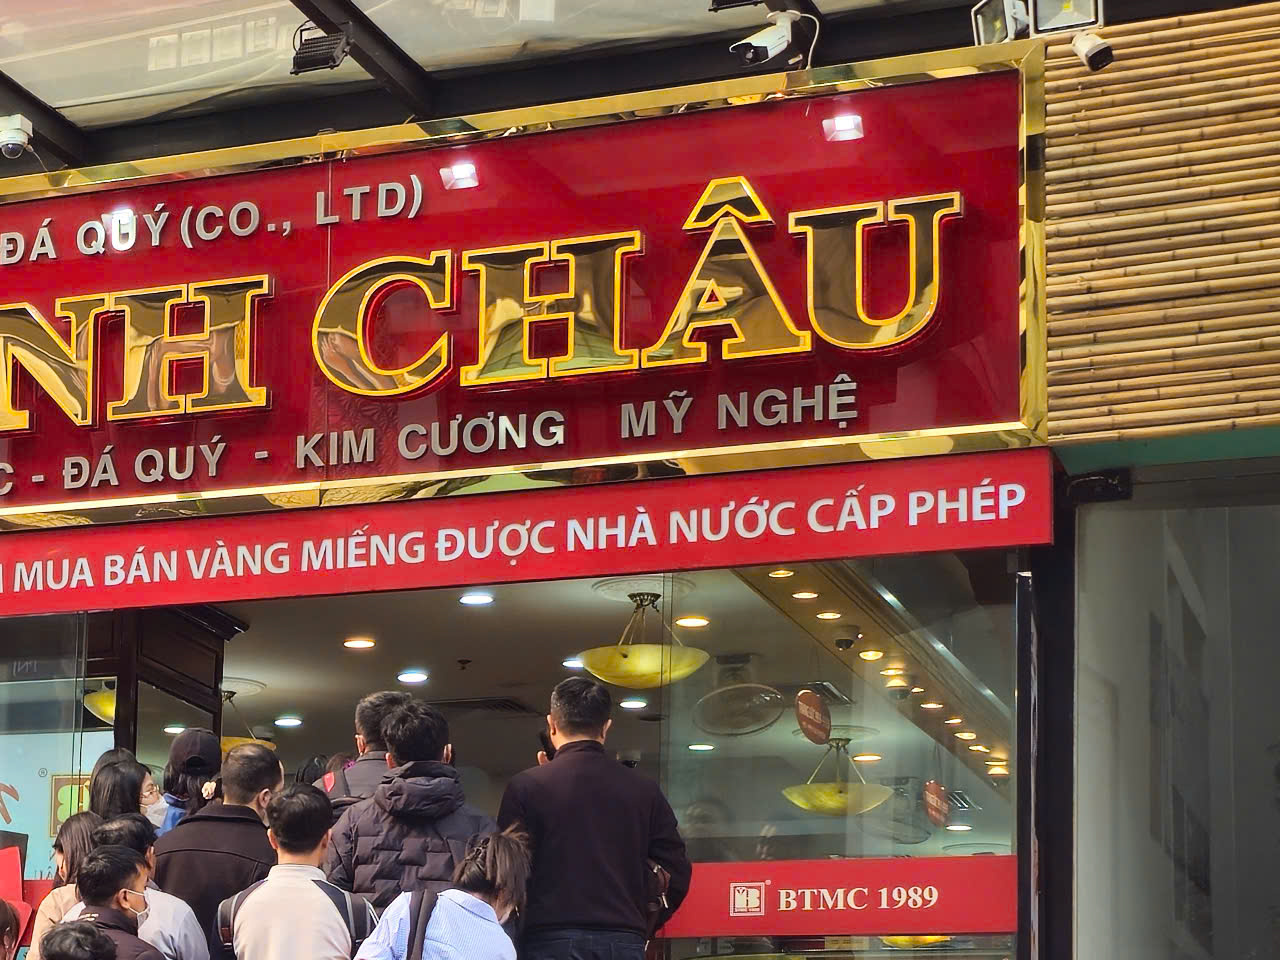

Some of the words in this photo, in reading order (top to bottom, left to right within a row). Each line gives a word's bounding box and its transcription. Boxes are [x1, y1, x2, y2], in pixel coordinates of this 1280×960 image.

[76, 202, 170, 256] QUÝ
[316, 174, 423, 226] LTD)
[311, 174, 962, 397] CHÂU
[62, 443, 119, 490] ĐÁ
[135, 434, 227, 484] QUÝ
[296, 429, 376, 468] KIM
[397, 410, 566, 461] CƯƠNG
[621, 388, 694, 439] MỸ
[717, 373, 859, 430] NGHỆ
[14, 558, 95, 595] MUA
[104, 546, 179, 586] BÁN
[184, 540, 291, 582] VÀNG
[301, 528, 425, 573] MIẾNG
[435, 518, 557, 568] ĐƯỢC
[567, 507, 654, 553] NHÀ
[669, 498, 796, 544] NƯỚC
[807, 482, 897, 535] CẤP
[907, 478, 1027, 527] PHÉP
[777, 886, 869, 912] BTMC
[878, 885, 939, 910] 1989
